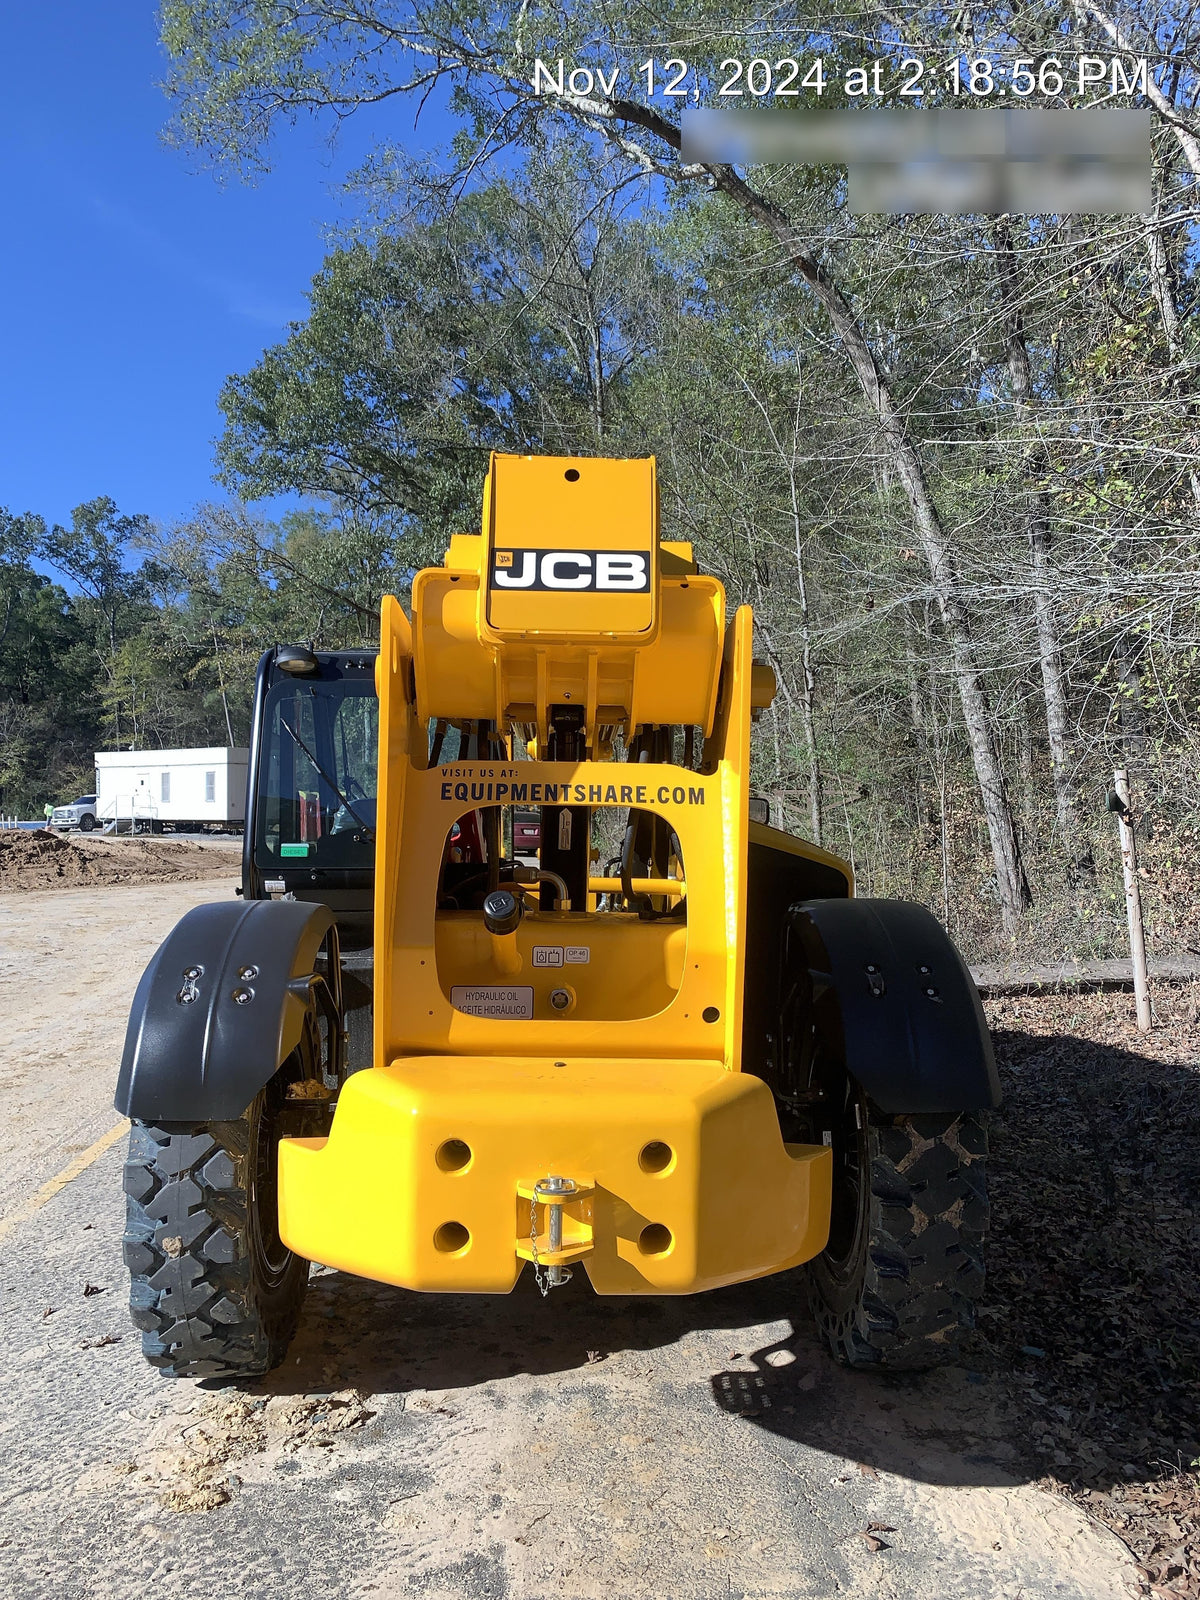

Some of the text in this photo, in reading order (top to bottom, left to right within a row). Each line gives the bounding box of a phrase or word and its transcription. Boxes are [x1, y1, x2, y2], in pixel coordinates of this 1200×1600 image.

[494, 551, 647, 590] JCB
[441, 768, 519, 778] VISIT US AT:
[440, 782, 705, 805] EQUIPMENTSHARE.COM
[465, 991, 519, 1001] HYDRAULIC OIL
[483, 1004, 527, 1015] HIDRÁULICO
